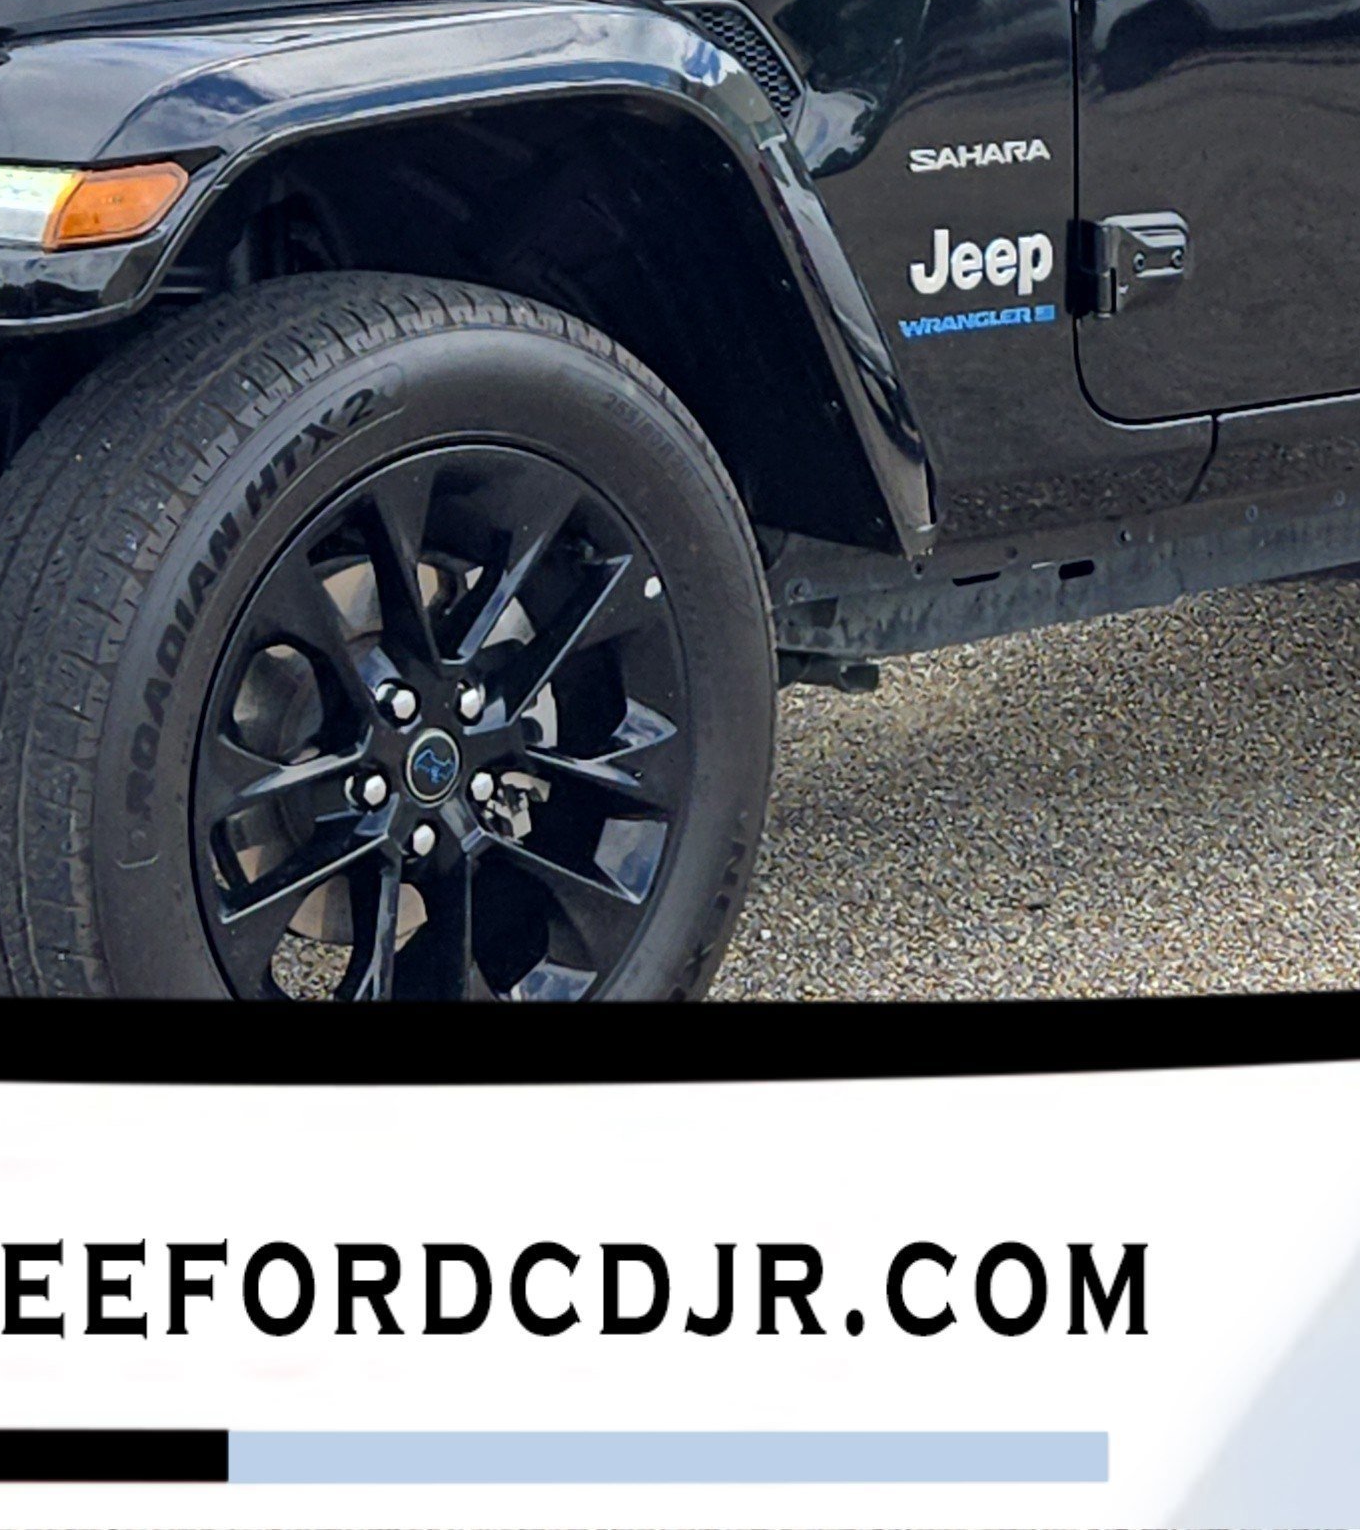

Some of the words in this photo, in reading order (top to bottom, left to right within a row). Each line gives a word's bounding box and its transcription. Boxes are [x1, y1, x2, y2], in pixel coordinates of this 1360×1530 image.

[908, 138, 1052, 172] SAHARA
[908, 228, 1054, 296] Jeep
[898, 306, 1032, 339] WRANGLER
[124, 511, 241, 820] ROADIAN
